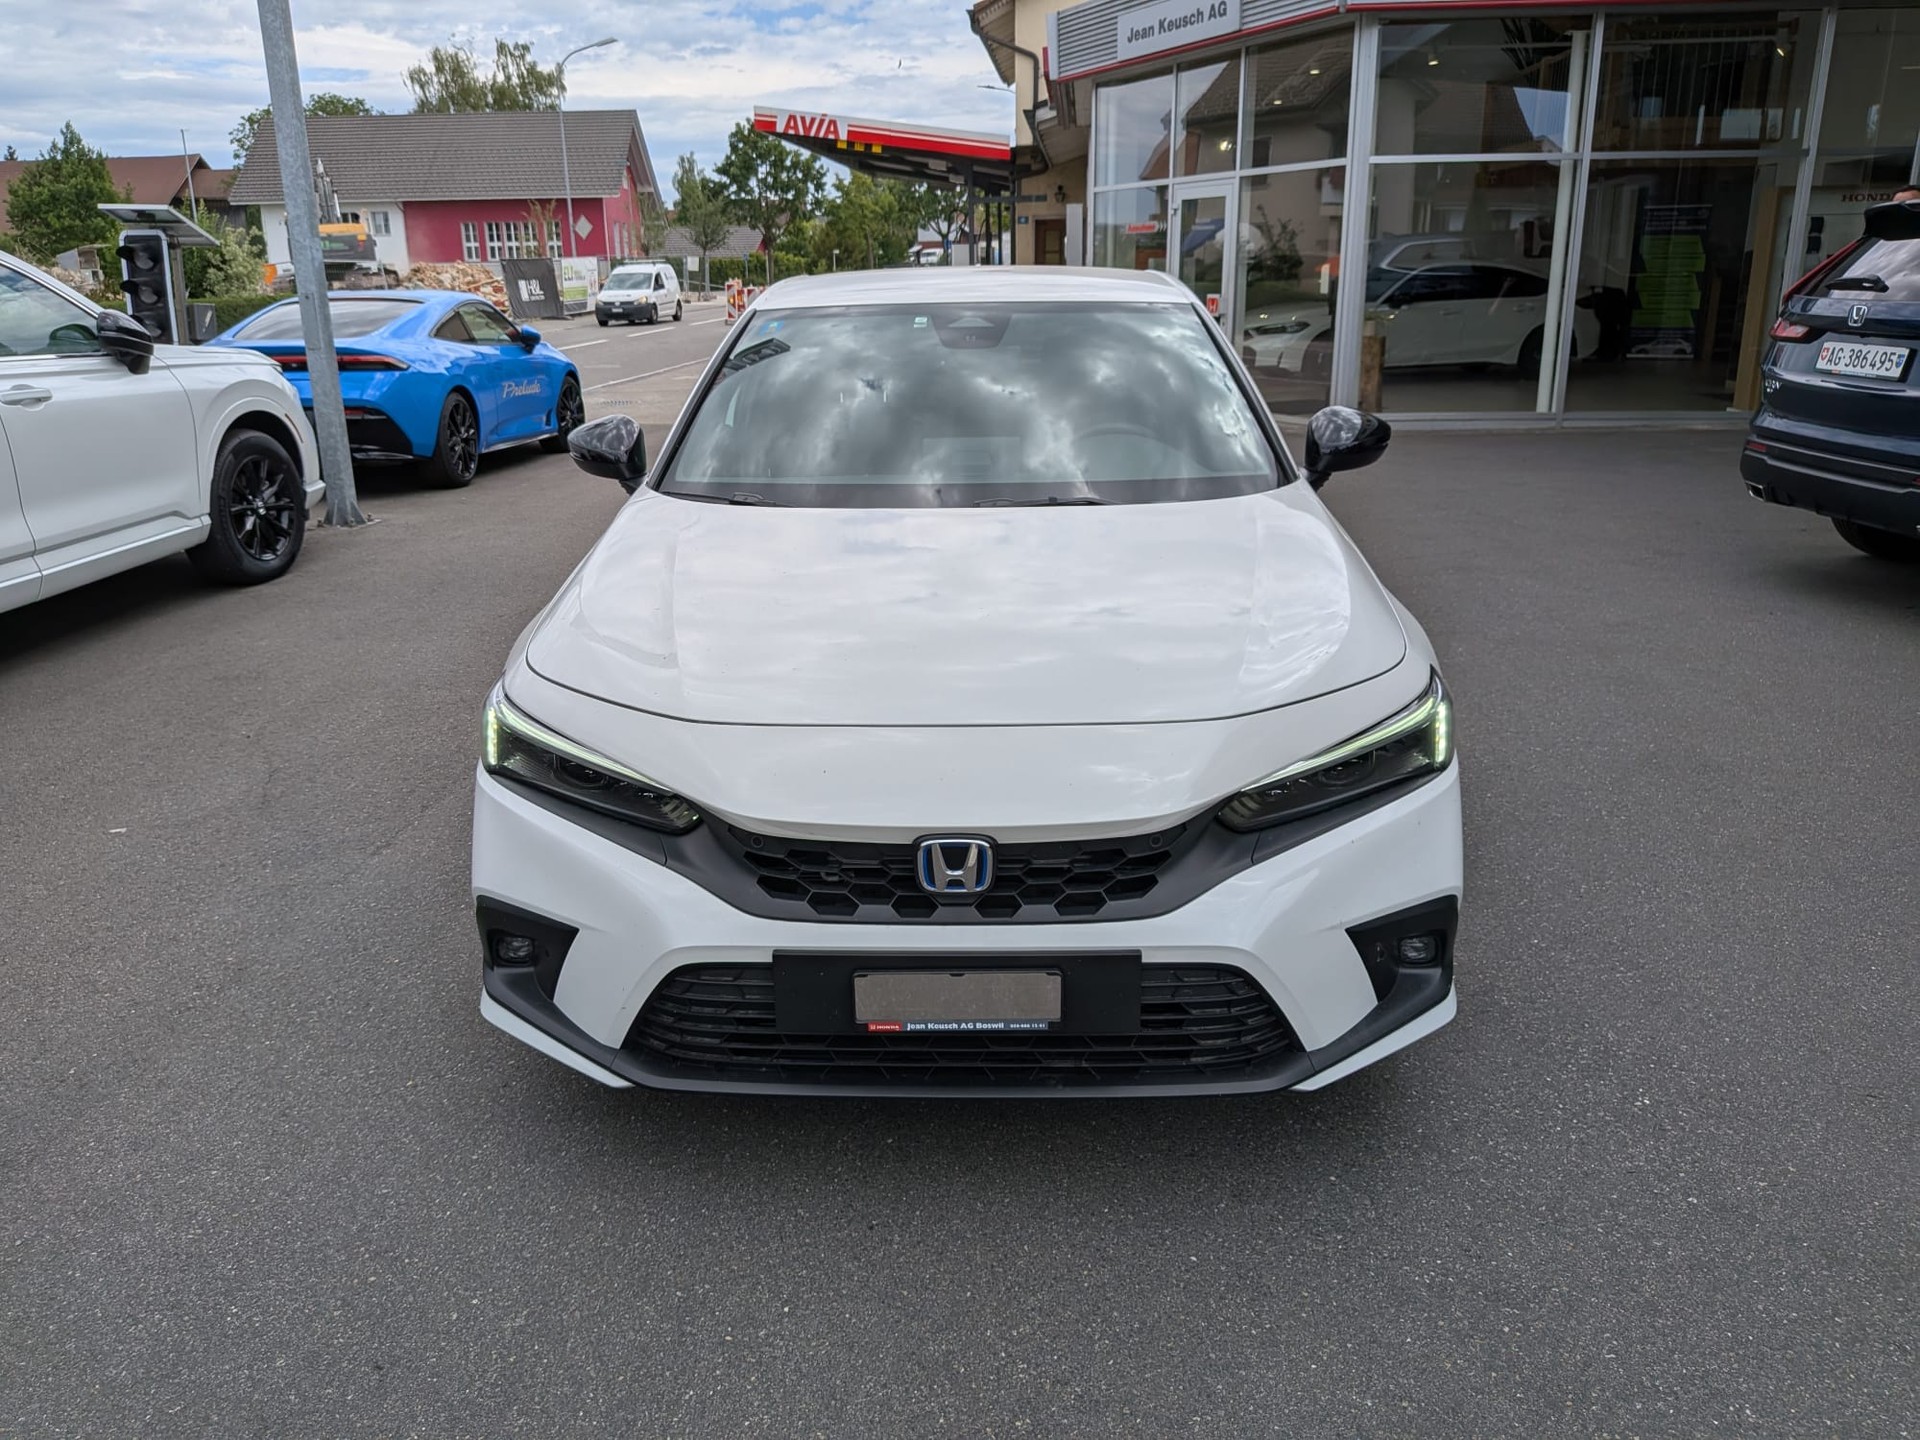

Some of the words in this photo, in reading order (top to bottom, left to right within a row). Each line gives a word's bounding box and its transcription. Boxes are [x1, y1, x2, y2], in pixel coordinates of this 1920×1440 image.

[1127, 27, 1155, 44] Jean
[1158, 9, 1204, 35] Keusch
[1208, 1, 1228, 22] AG
[502, 379, 542, 399] Prelude
[907, 1022, 926, 1031] Jean
[928, 1022, 959, 1030] Keusch
[976, 1021, 1004, 1029] Boswil
